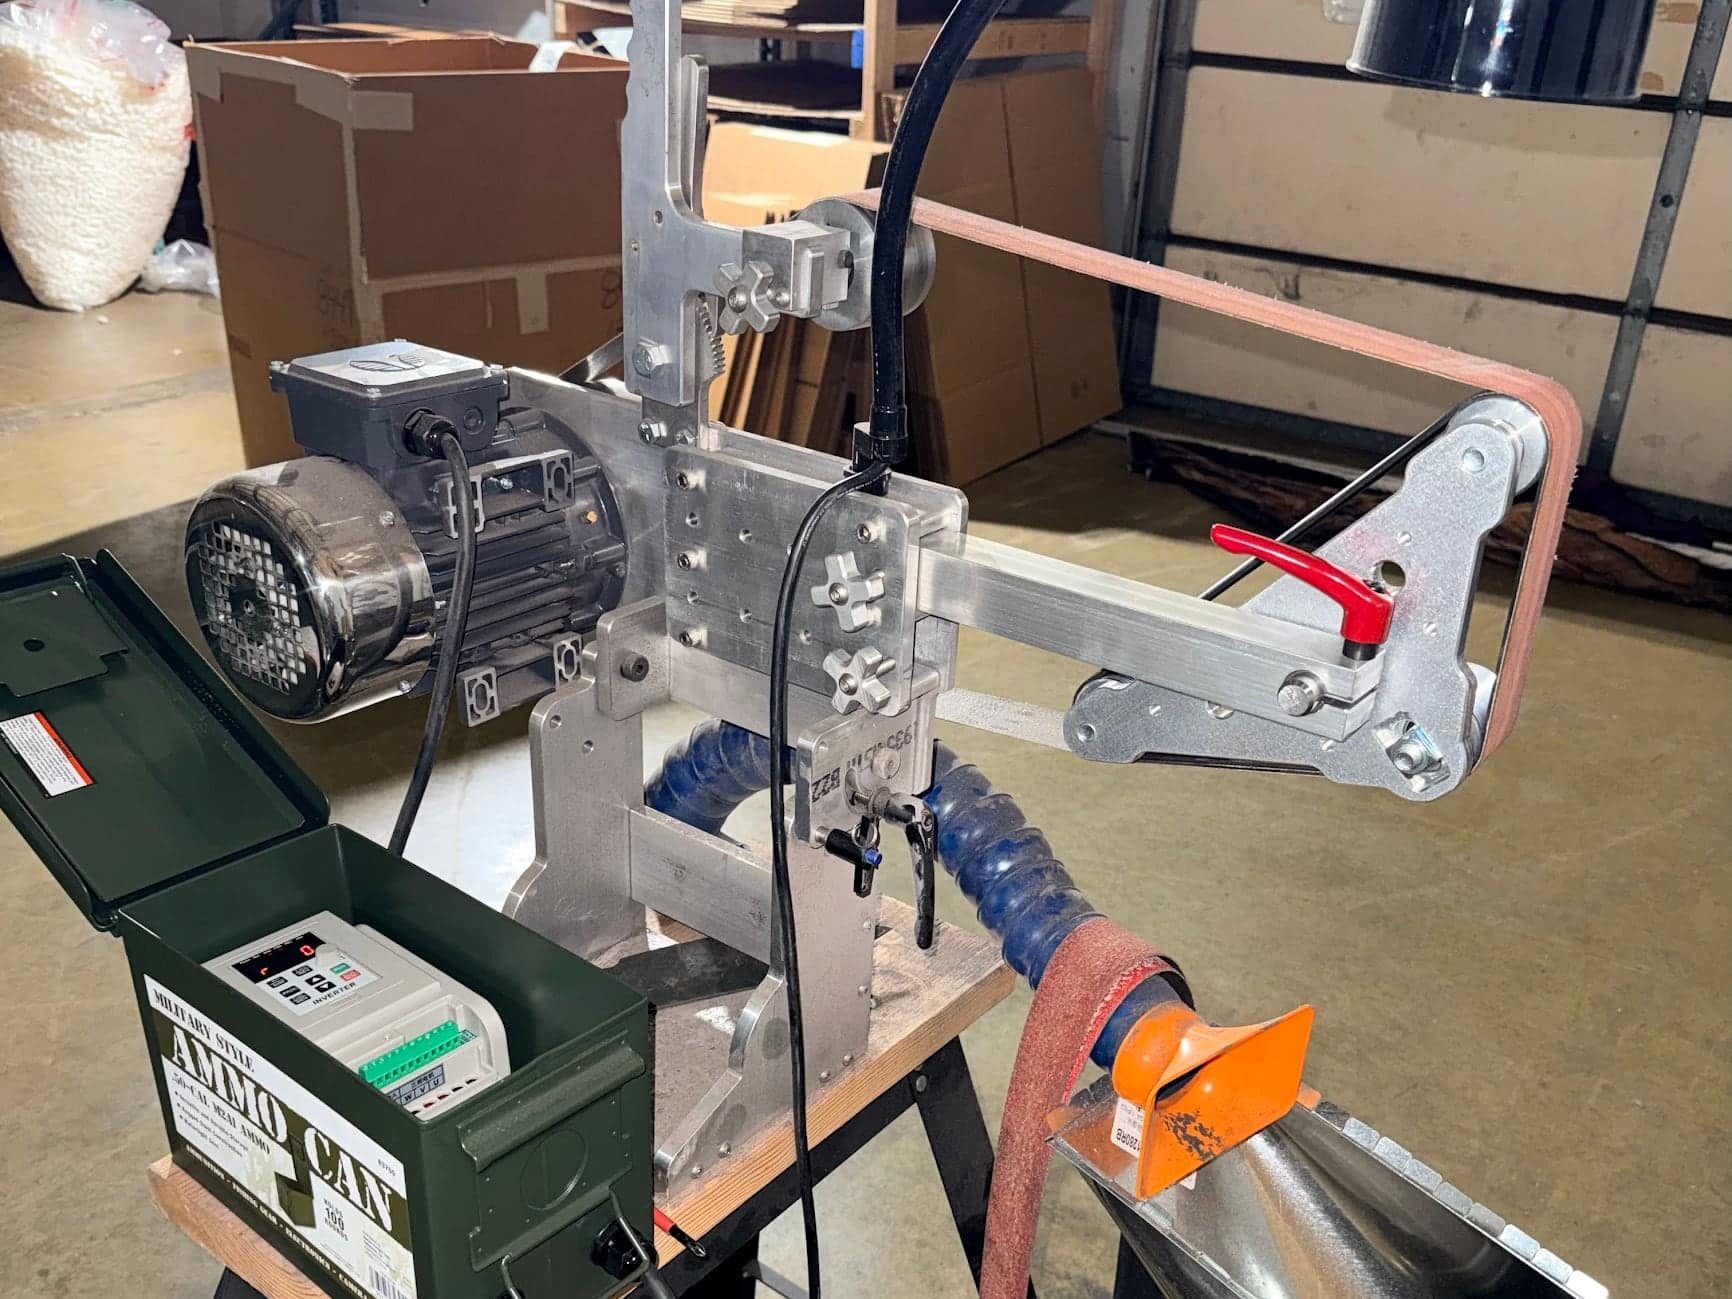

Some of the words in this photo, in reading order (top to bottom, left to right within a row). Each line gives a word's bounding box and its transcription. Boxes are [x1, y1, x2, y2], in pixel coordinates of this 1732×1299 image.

[312, 981, 356, 1006] INVERTER
[153, 988, 211, 1041] MILITARY
[215, 1032, 255, 1073] STYLE
[172, 1025, 289, 1143] AMMO
[305, 1126, 393, 1232] CAN
[240, 1124, 270, 1155] AMMO
[326, 1207, 345, 1231] 100
